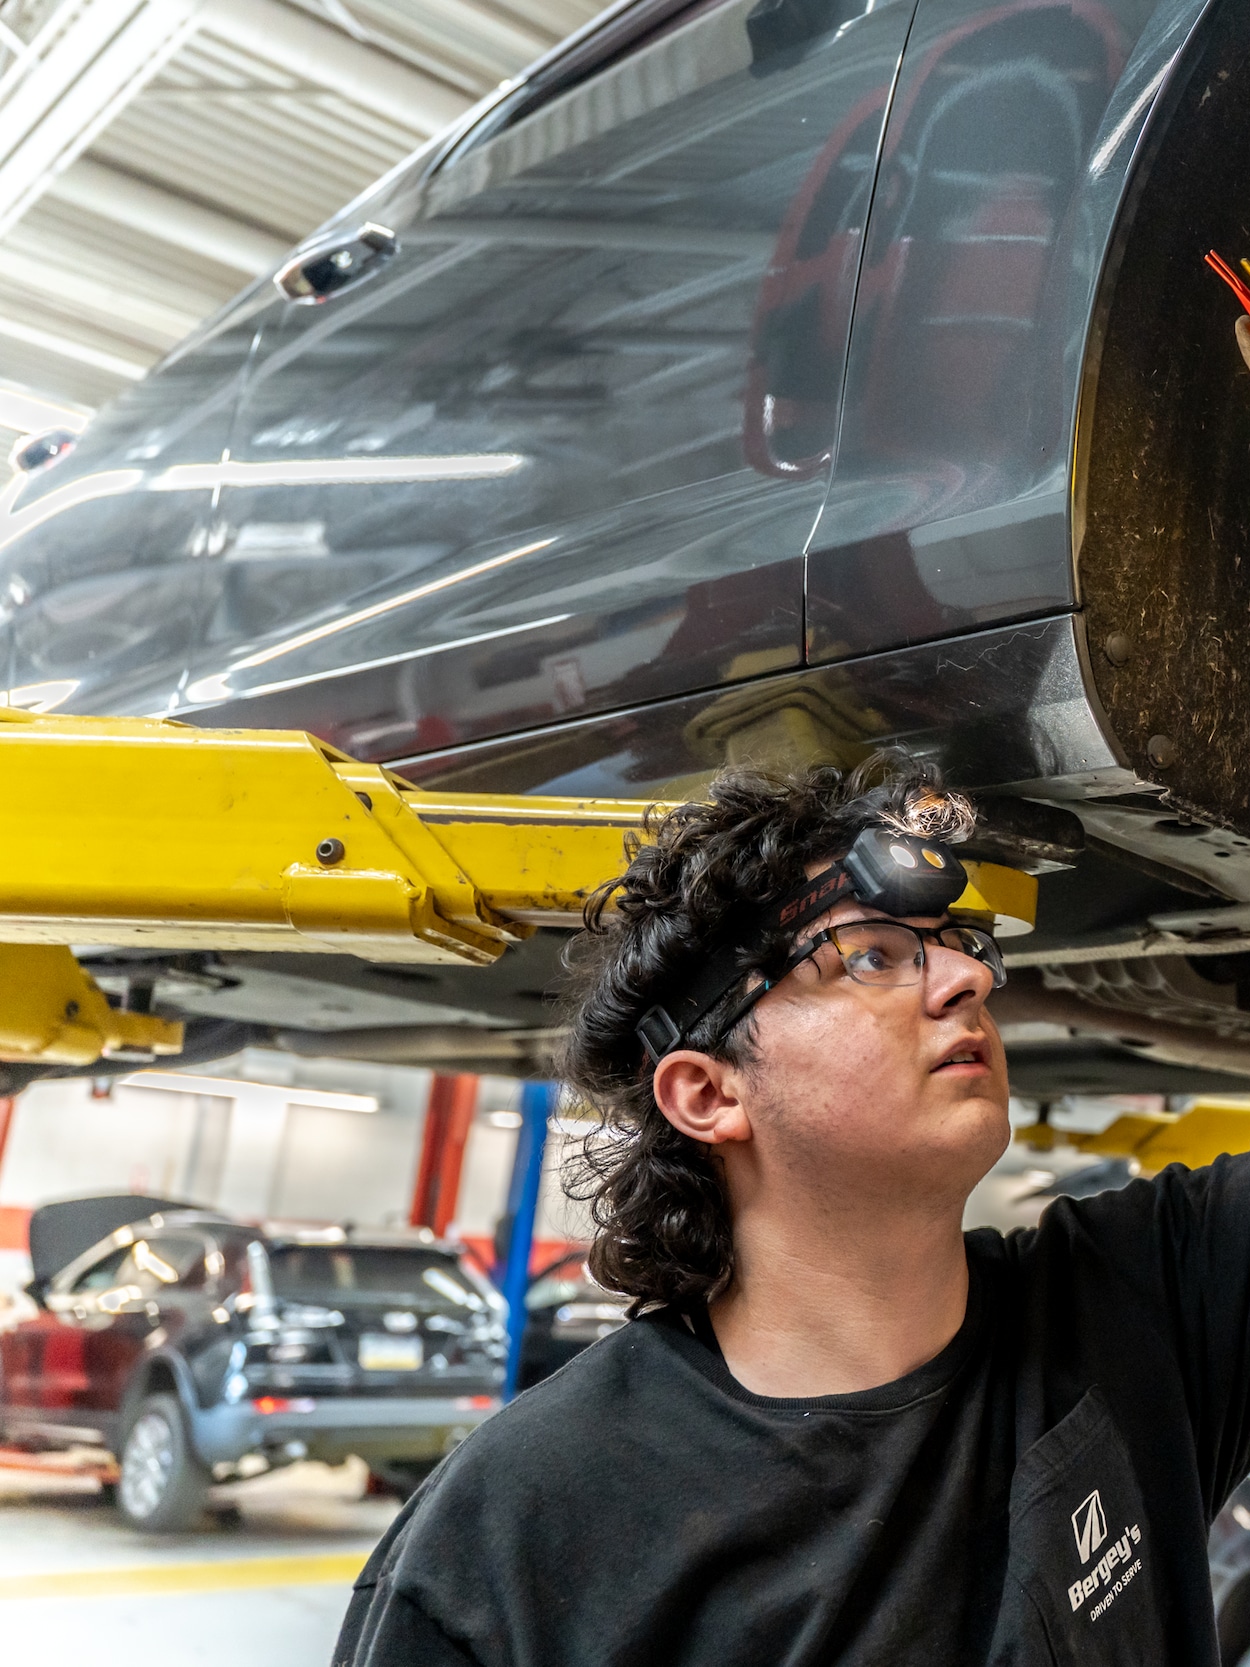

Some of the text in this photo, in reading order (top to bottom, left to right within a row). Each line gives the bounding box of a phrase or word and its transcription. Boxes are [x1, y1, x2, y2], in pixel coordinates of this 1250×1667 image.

[1067, 1523, 1142, 1613] Bergey's
[1090, 1558, 1143, 1622] DRIVEN TO SERVE
